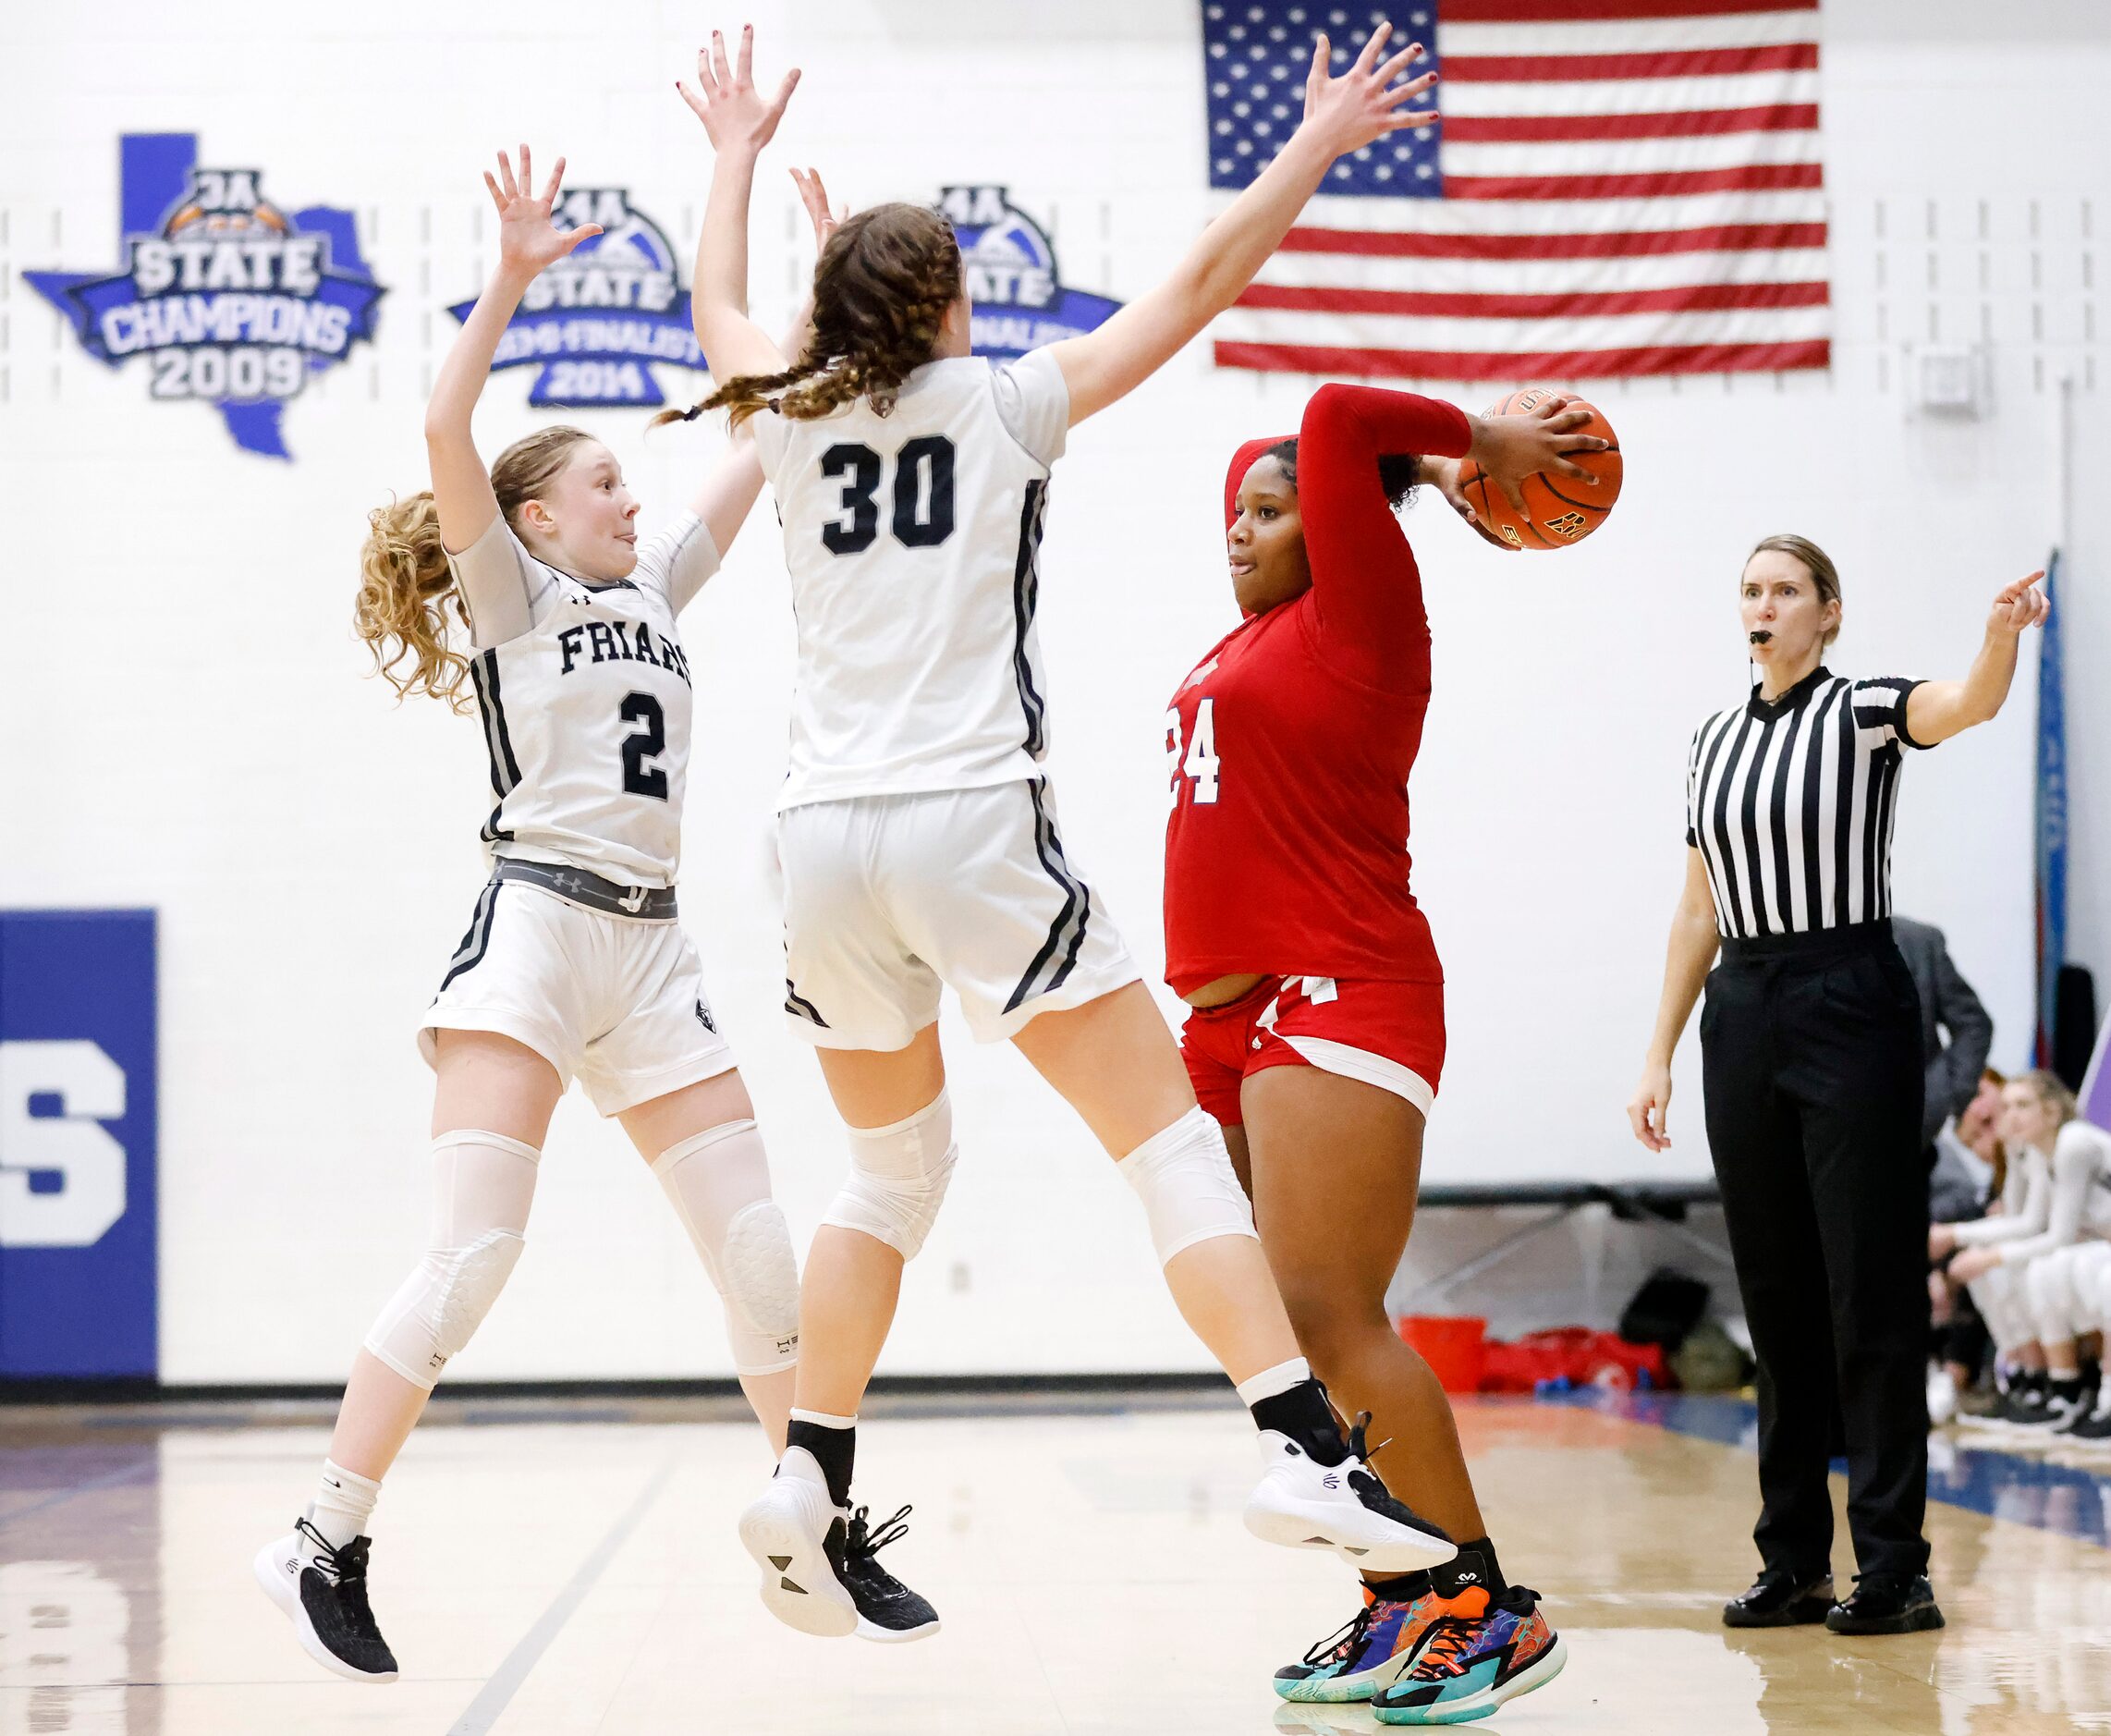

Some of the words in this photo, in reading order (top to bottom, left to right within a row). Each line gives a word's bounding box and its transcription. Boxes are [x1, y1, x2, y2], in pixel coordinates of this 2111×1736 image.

[135, 240, 320, 297] STATE
[524, 268, 677, 311] STATE
[966, 264, 1055, 308] ATE
[101, 292, 352, 355] CHAMPIONS
[153, 347, 303, 397] 2009
[545, 361, 644, 398] 2014
[819, 434, 958, 557] 30
[618, 690, 668, 801] 2
